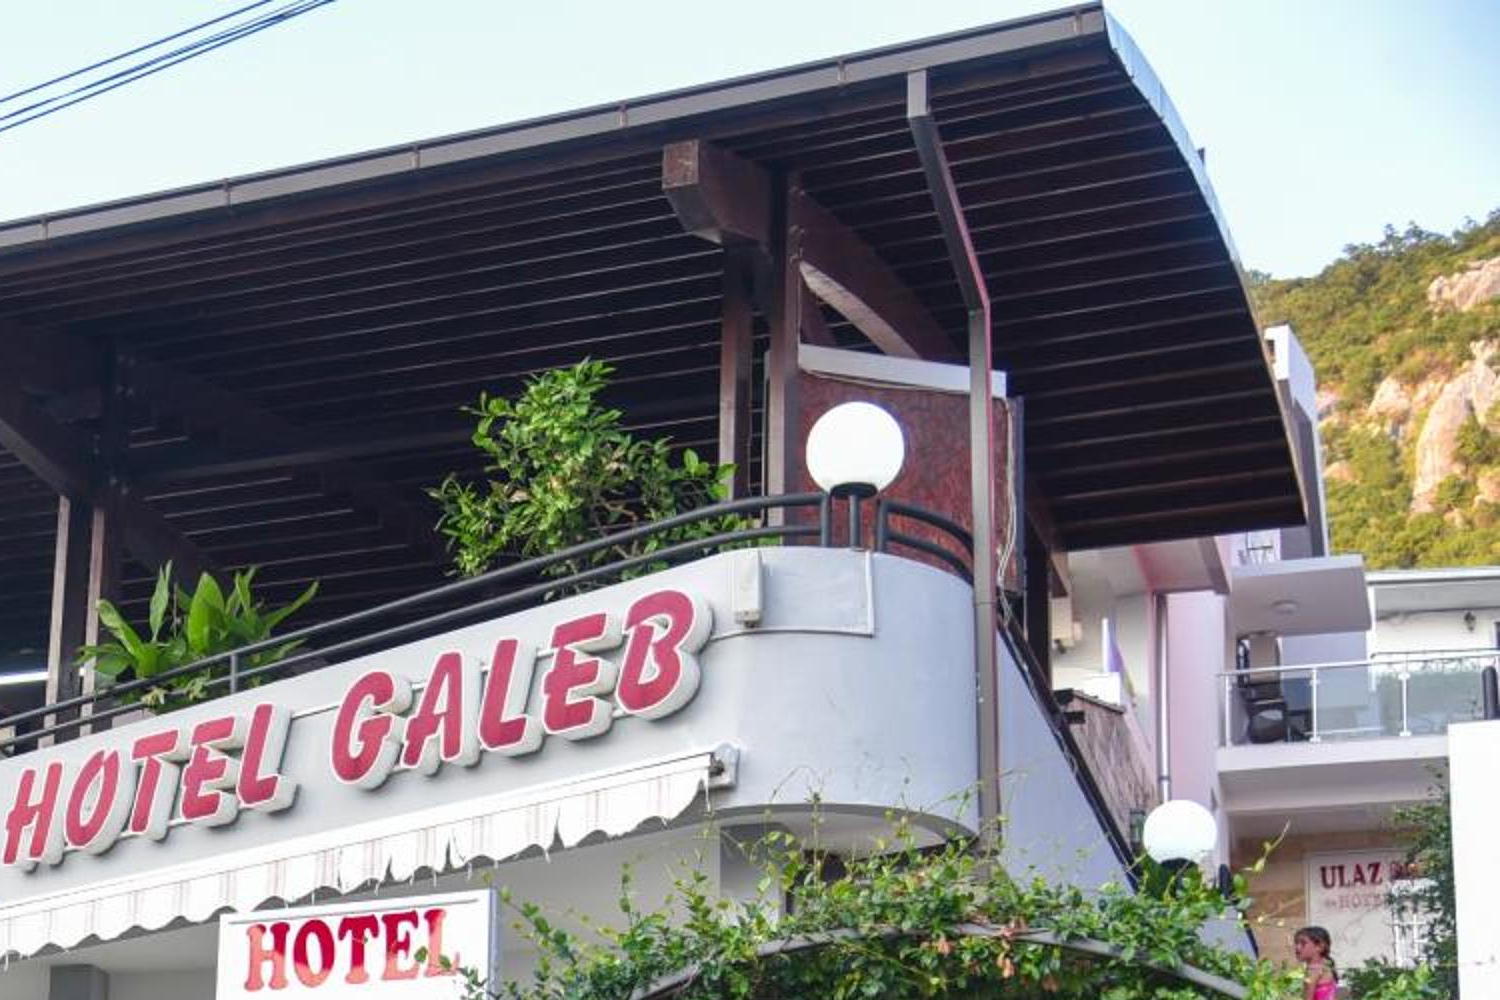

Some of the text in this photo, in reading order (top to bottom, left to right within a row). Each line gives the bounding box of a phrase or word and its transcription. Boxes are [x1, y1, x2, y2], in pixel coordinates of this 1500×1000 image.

[2, 588, 698, 867] HOTEL GALEB
[1319, 862, 1384, 889] ULAZ
[244, 908, 461, 992] HOTEL
